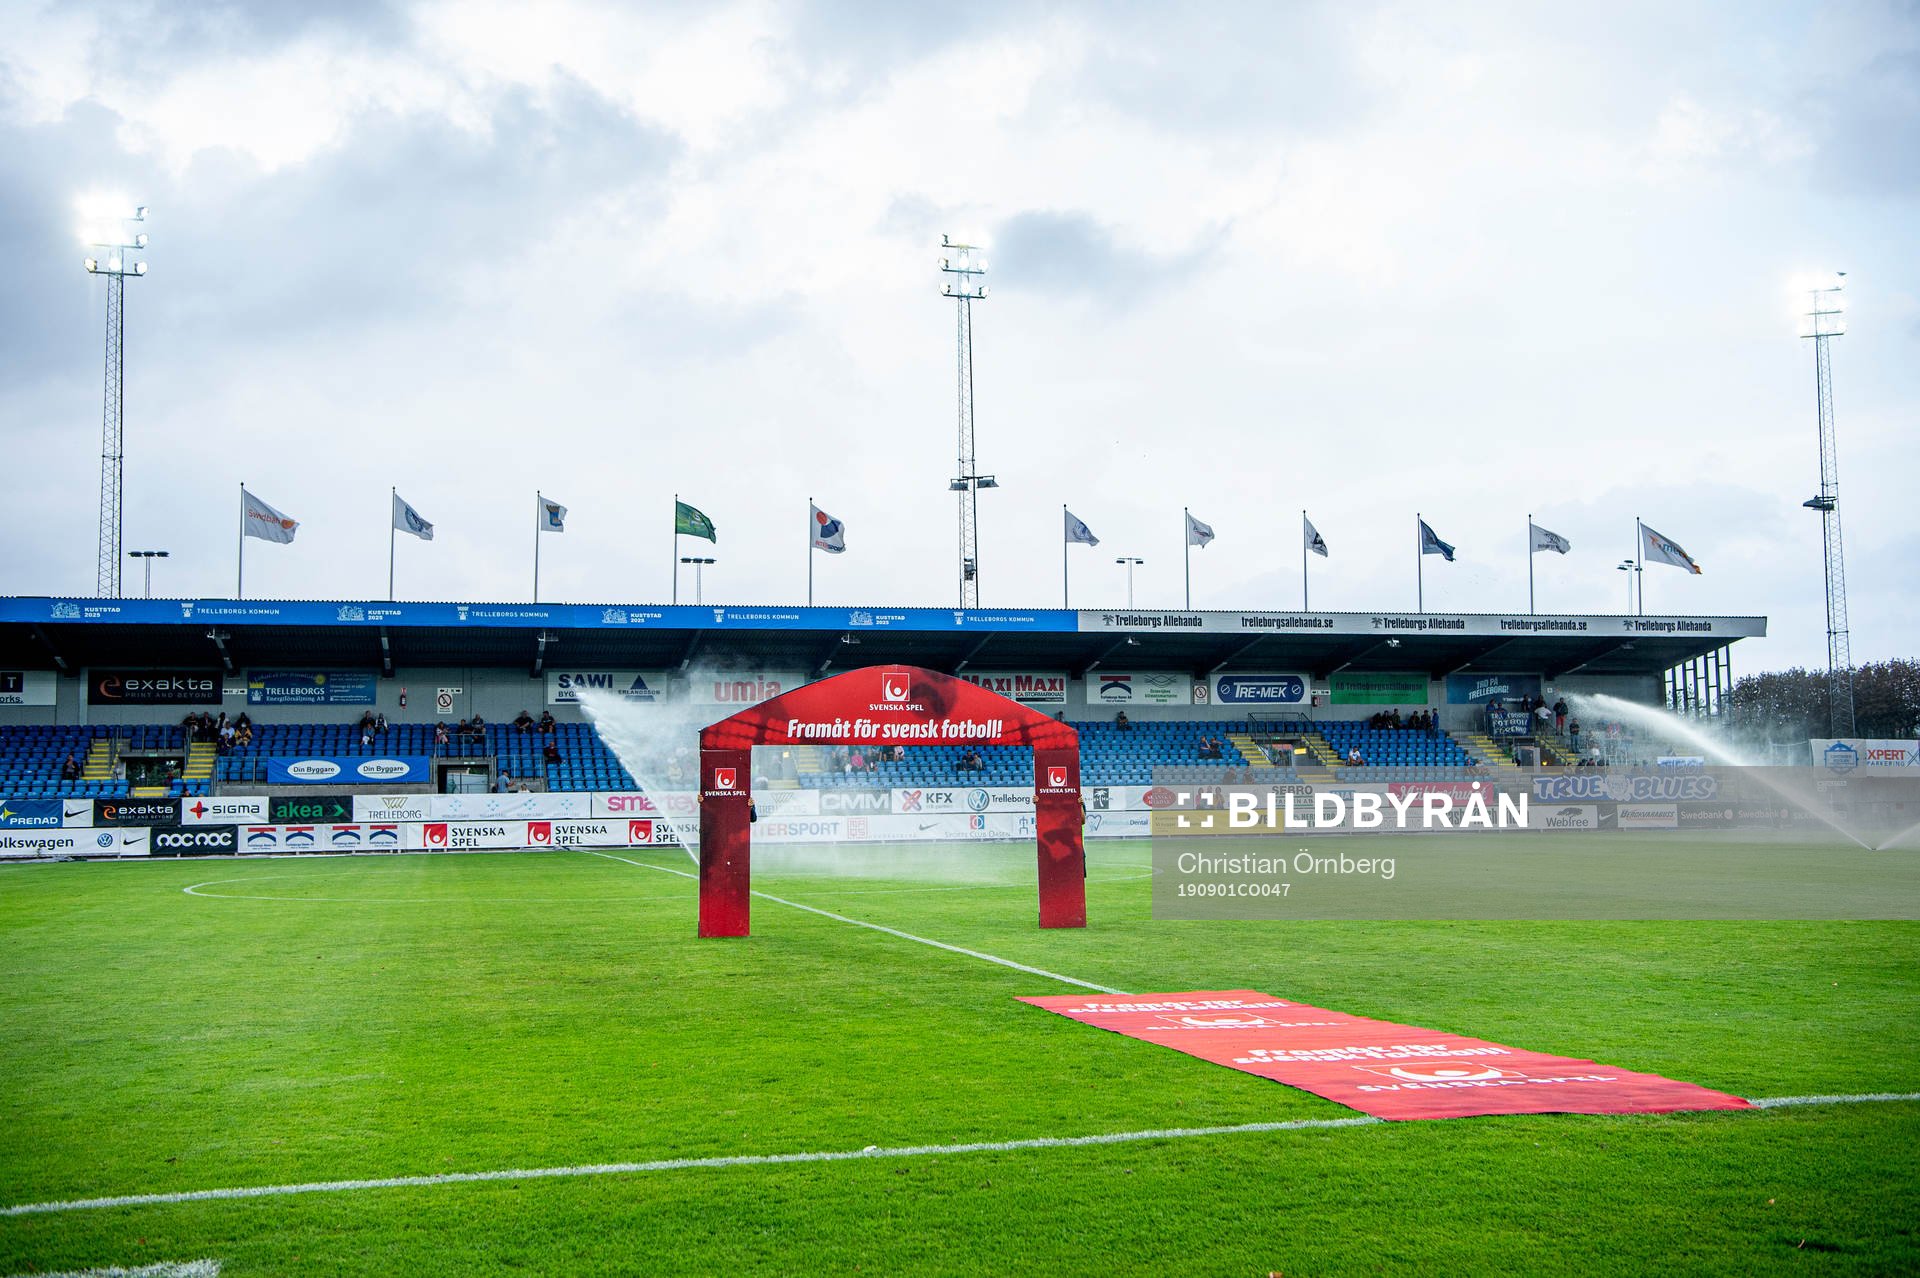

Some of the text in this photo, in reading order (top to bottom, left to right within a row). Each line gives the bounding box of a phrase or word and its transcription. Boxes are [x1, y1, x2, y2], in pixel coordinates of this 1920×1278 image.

[197, 607, 247, 615] TRELLEBORGS
[1115, 615, 1203, 628] Trelleborgs Allehanda
[1241, 616, 1334, 629] trelleborgsallehanda.se
[1384, 617, 1465, 630] Trelleborgs Allehanda
[1500, 618, 1588, 631] trelleborgsallehanda.se
[1634, 619, 1712, 632] Trelleborgs Allehanda
[7, 676, 17, 689] T
[125, 676, 213, 690] exakta
[558, 674, 613, 689] SAWI
[1015, 675, 1064, 691] MAXI
[266, 687, 325, 695] TRELLEBORGS
[714, 675, 782, 702] umia
[1233, 681, 1288, 699] TRE-MEK
[869, 703, 924, 711] SVENSKA SPEL
[787, 718, 1003, 739] Framåt för svensk fotboll!
[293, 765, 335, 775] Din Byggare
[376, 765, 404, 775] Byggare
[1534, 775, 1603, 799] TRUE
[1631, 775, 1717, 799] BLUES
[821, 794, 889, 810] CMM
[926, 792, 953, 804] KFX
[992, 794, 1031, 804] Trelleborg
[118, 805, 174, 814] exakta
[277, 802, 324, 818] akea
[368, 810, 422, 819] TRELLEBORG
[1680, 809, 1724, 820] Swedbank
[1738, 808, 1779, 819] Swedbank
[10, 816, 59, 825] PRENAD
[451, 827, 506, 837] SVENSKA
[555, 825, 608, 835] SVENSKA
[451, 837, 480, 847] SPEL
[555, 835, 583, 845] SPEL
